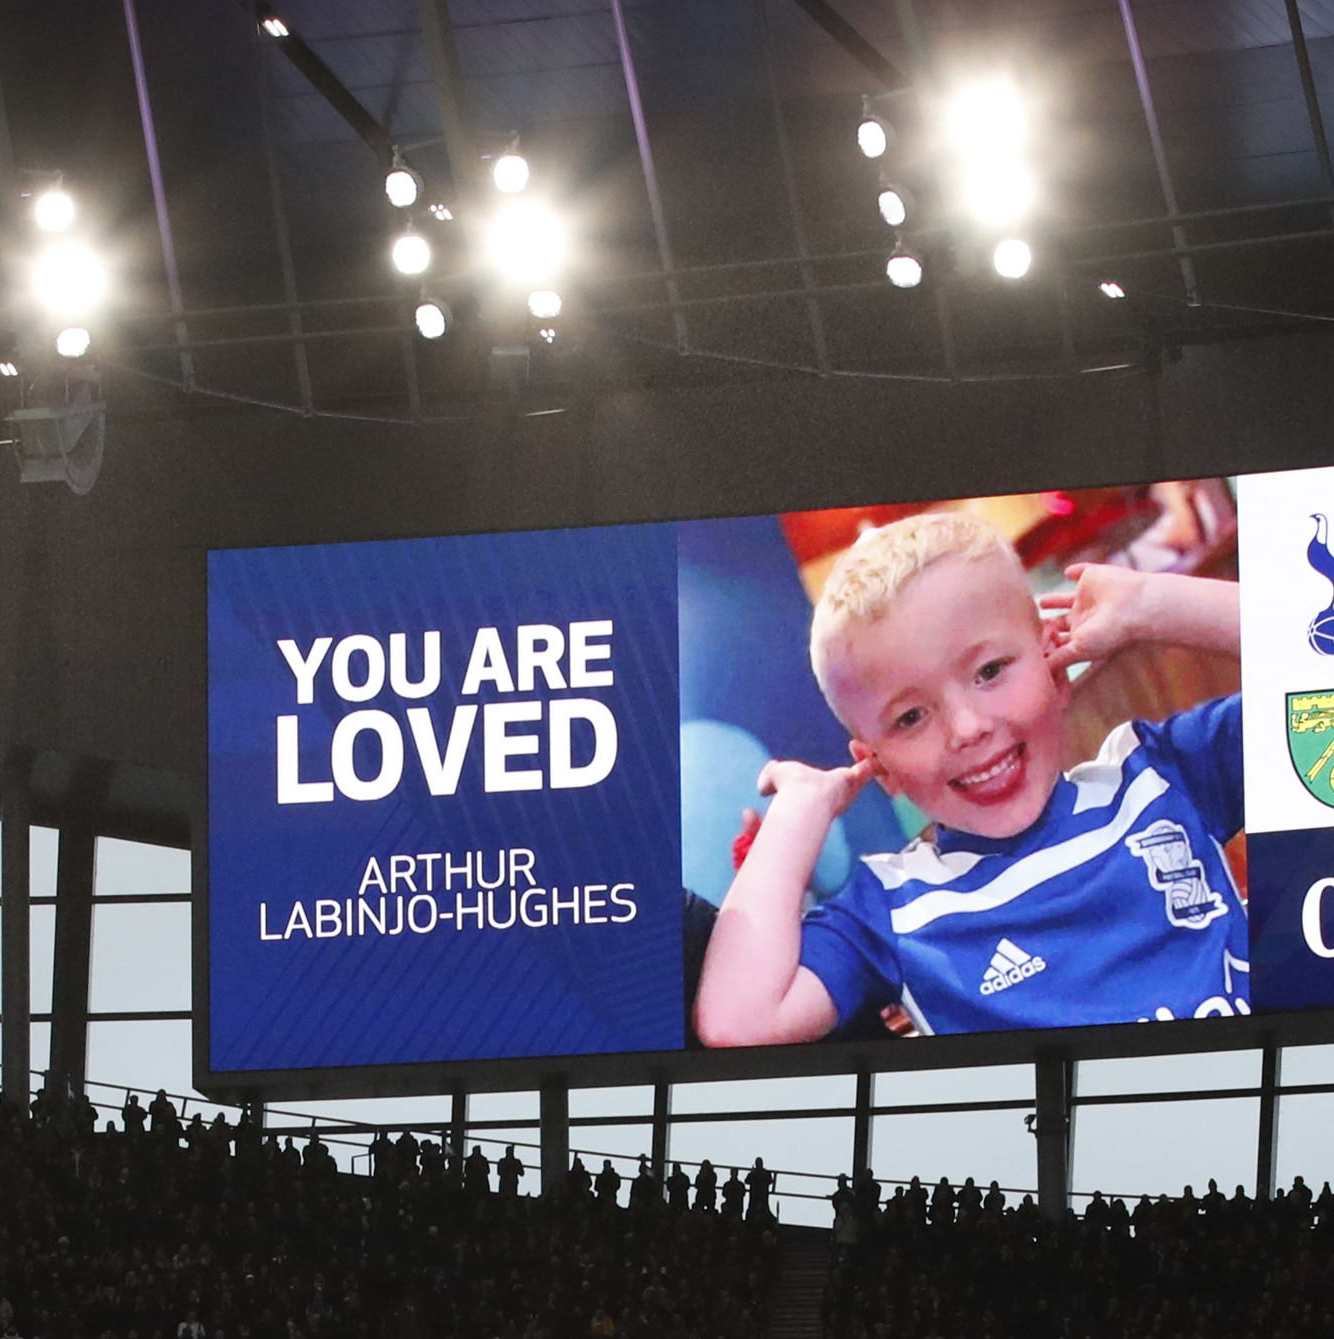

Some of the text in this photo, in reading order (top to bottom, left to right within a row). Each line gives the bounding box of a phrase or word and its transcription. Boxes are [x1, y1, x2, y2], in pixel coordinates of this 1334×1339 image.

[276, 619, 614, 705] YOU ARE
[276, 697, 618, 805] LOVED
[358, 848, 537, 896] ARTHUR
[260, 883, 637, 941] LABINJO-HUGHES
[979, 956, 1047, 996] adidas
